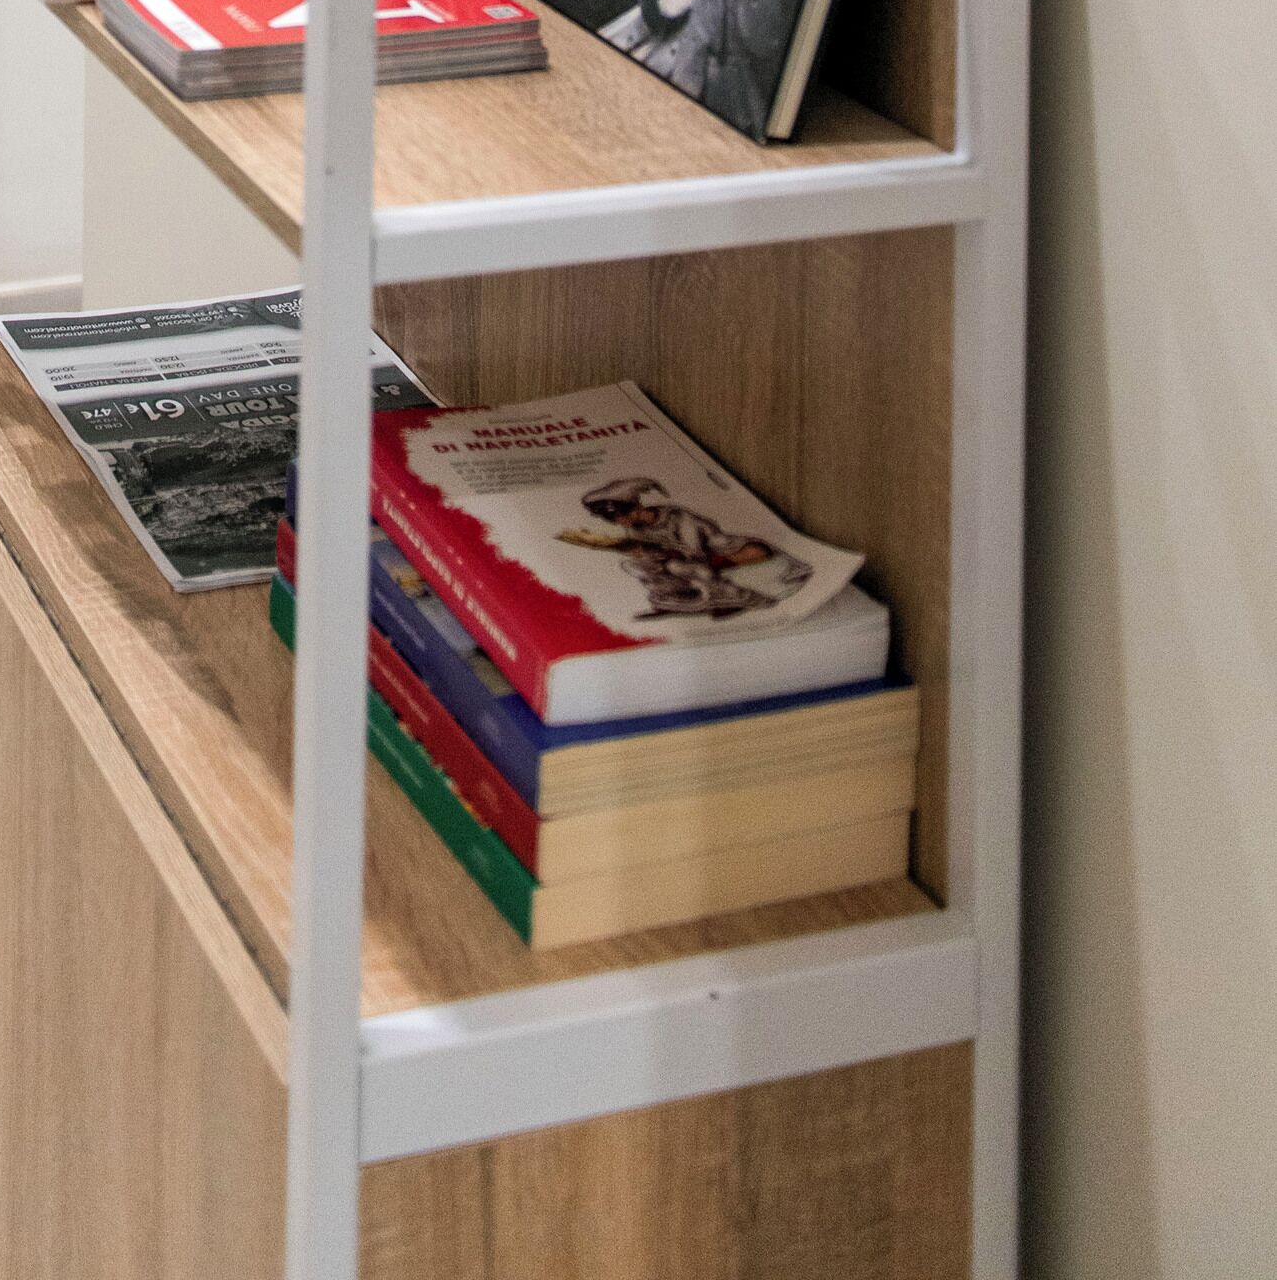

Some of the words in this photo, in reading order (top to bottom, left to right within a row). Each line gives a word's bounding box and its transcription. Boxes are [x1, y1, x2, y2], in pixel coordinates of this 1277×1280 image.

[23, 320, 134, 334] www.ontanotravel.com
[198, 389, 240, 404] DAY
[248, 382, 292, 396] ONE
[80, 407, 111, 420] 47€
[123, 399, 185, 421] 61€
[205, 396, 285, 417] TOUR
[433, 443, 460, 454] DI
[467, 420, 650, 452] NAPOLETANITÀ
[472, 418, 589, 439] MANUALE
